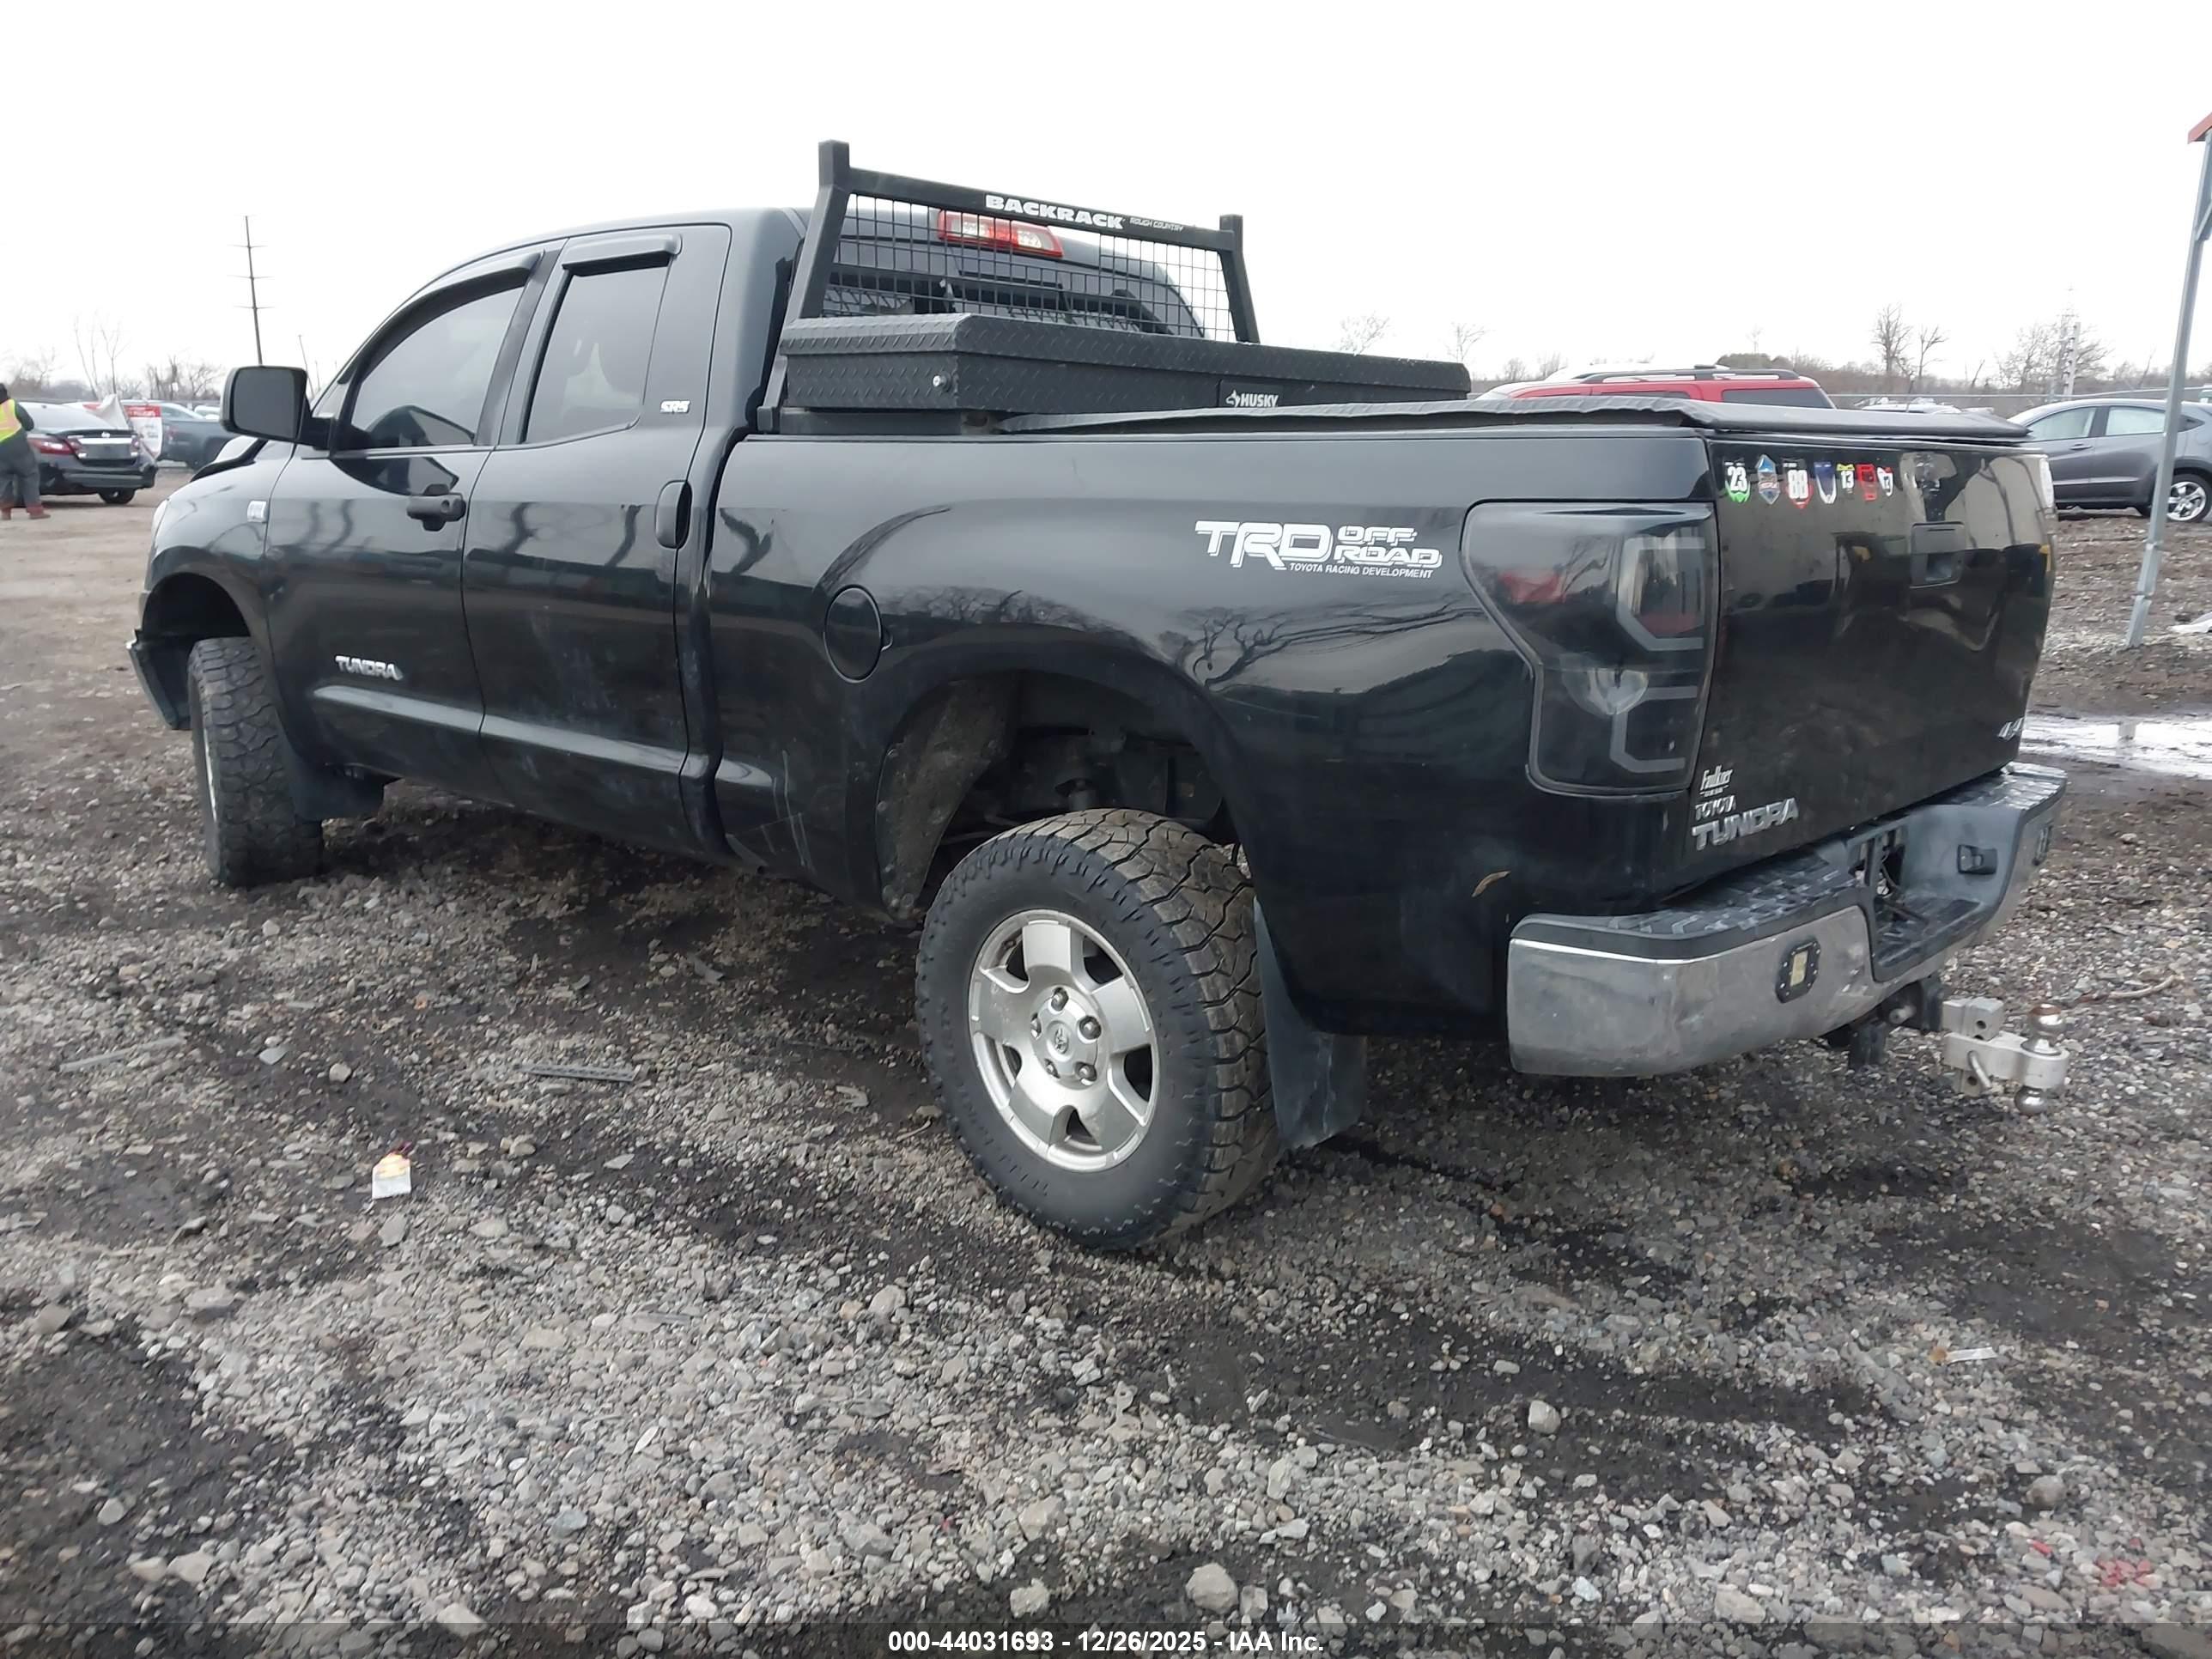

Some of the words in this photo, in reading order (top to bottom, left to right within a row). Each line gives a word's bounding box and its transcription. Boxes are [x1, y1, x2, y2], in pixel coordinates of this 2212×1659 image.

[985, 194, 1124, 229] BACKRACK
[1129, 217, 1153, 227] ROUGH
[1153, 219, 1184, 232] COUNTRY
[1240, 393, 1279, 407] HUSKY
[1727, 466, 1748, 492] 23
[1788, 470, 1808, 499] 88
[1841, 471, 1855, 489] 13
[1194, 520, 1334, 570] TRD
[1337, 525, 1417, 545] OFF
[1334, 544, 1443, 568] ROAD
[1289, 562, 1323, 574] TOYOTA
[1325, 563, 1360, 575] RACING
[1362, 566, 1434, 579] DEVELOPMENT
[335, 655, 404, 681] TUNDRA
[1695, 795, 1736, 821] TOYOTA
[1692, 798, 1799, 851] TUNDRA
